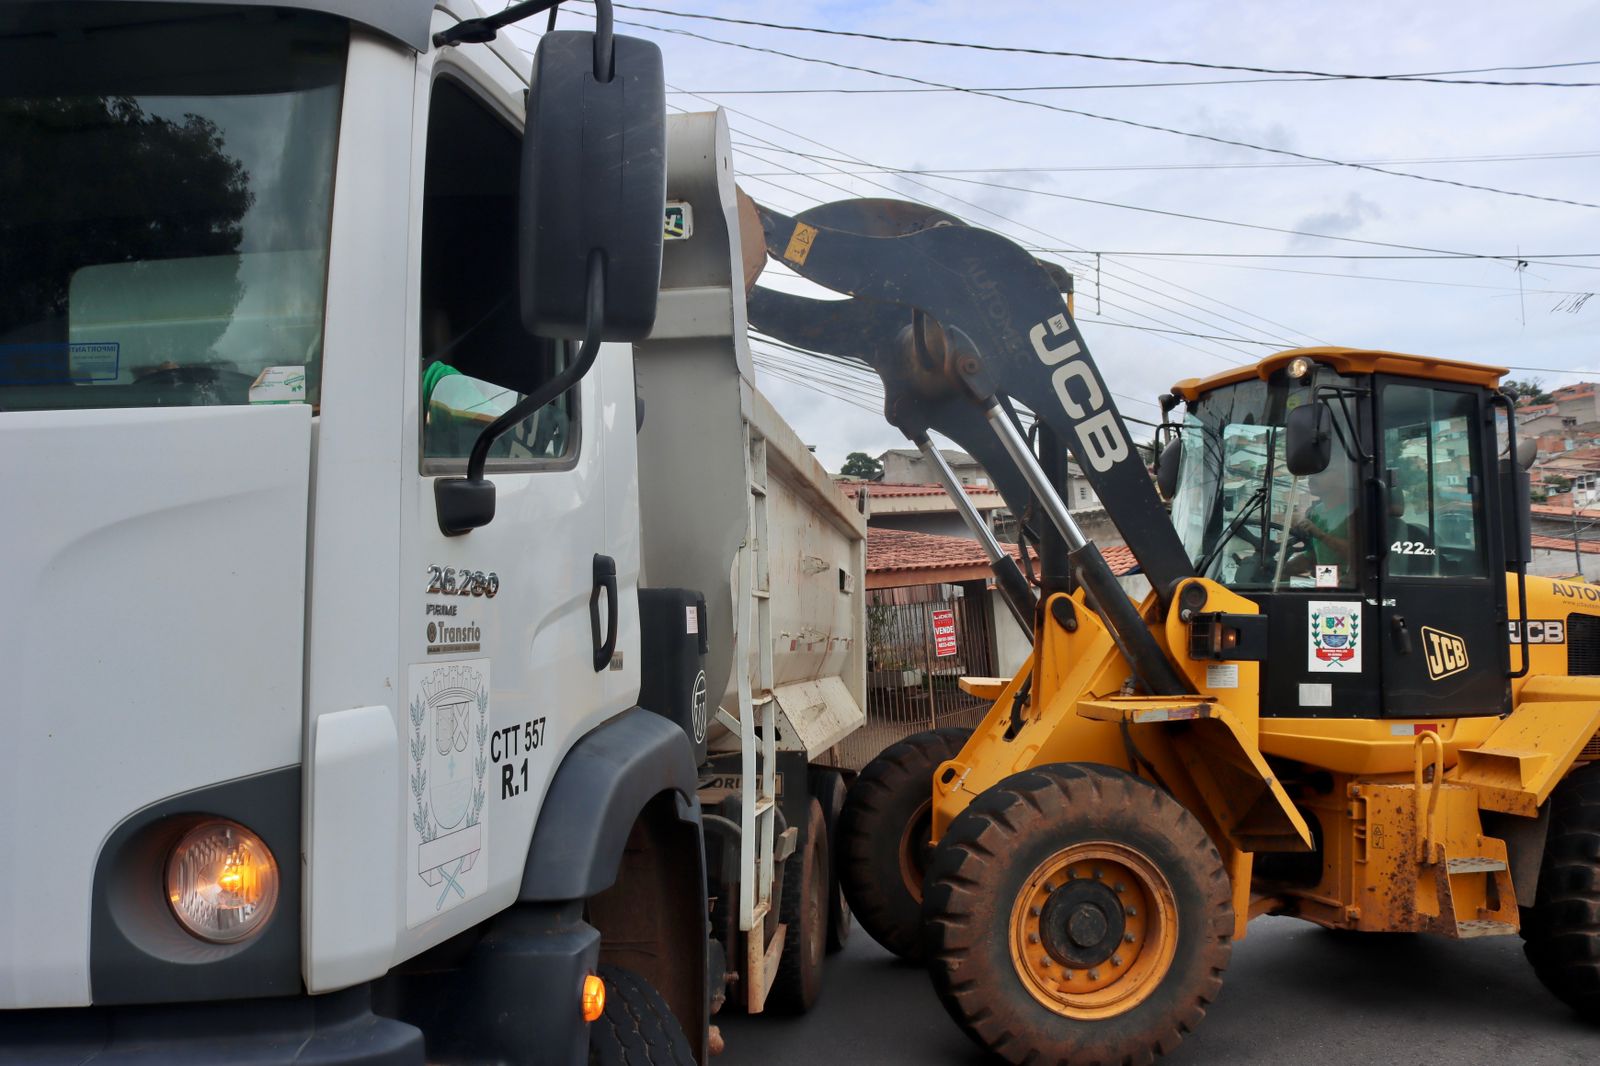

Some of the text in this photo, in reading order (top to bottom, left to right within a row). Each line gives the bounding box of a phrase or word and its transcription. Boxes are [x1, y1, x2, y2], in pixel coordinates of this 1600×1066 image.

[1029, 312, 1129, 473] JCB
[1390, 541, 1436, 556] 422ZX
[1552, 582, 1600, 602] AUTO
[425, 603, 458, 617] PRIME
[438, 620, 481, 643] Transrio
[935, 626, 955, 635] VENDE
[1508, 621, 1564, 643] JCB
[1429, 632, 1466, 675] JCB
[490, 715, 547, 764] CTT 557
[501, 757, 529, 801] R.1
